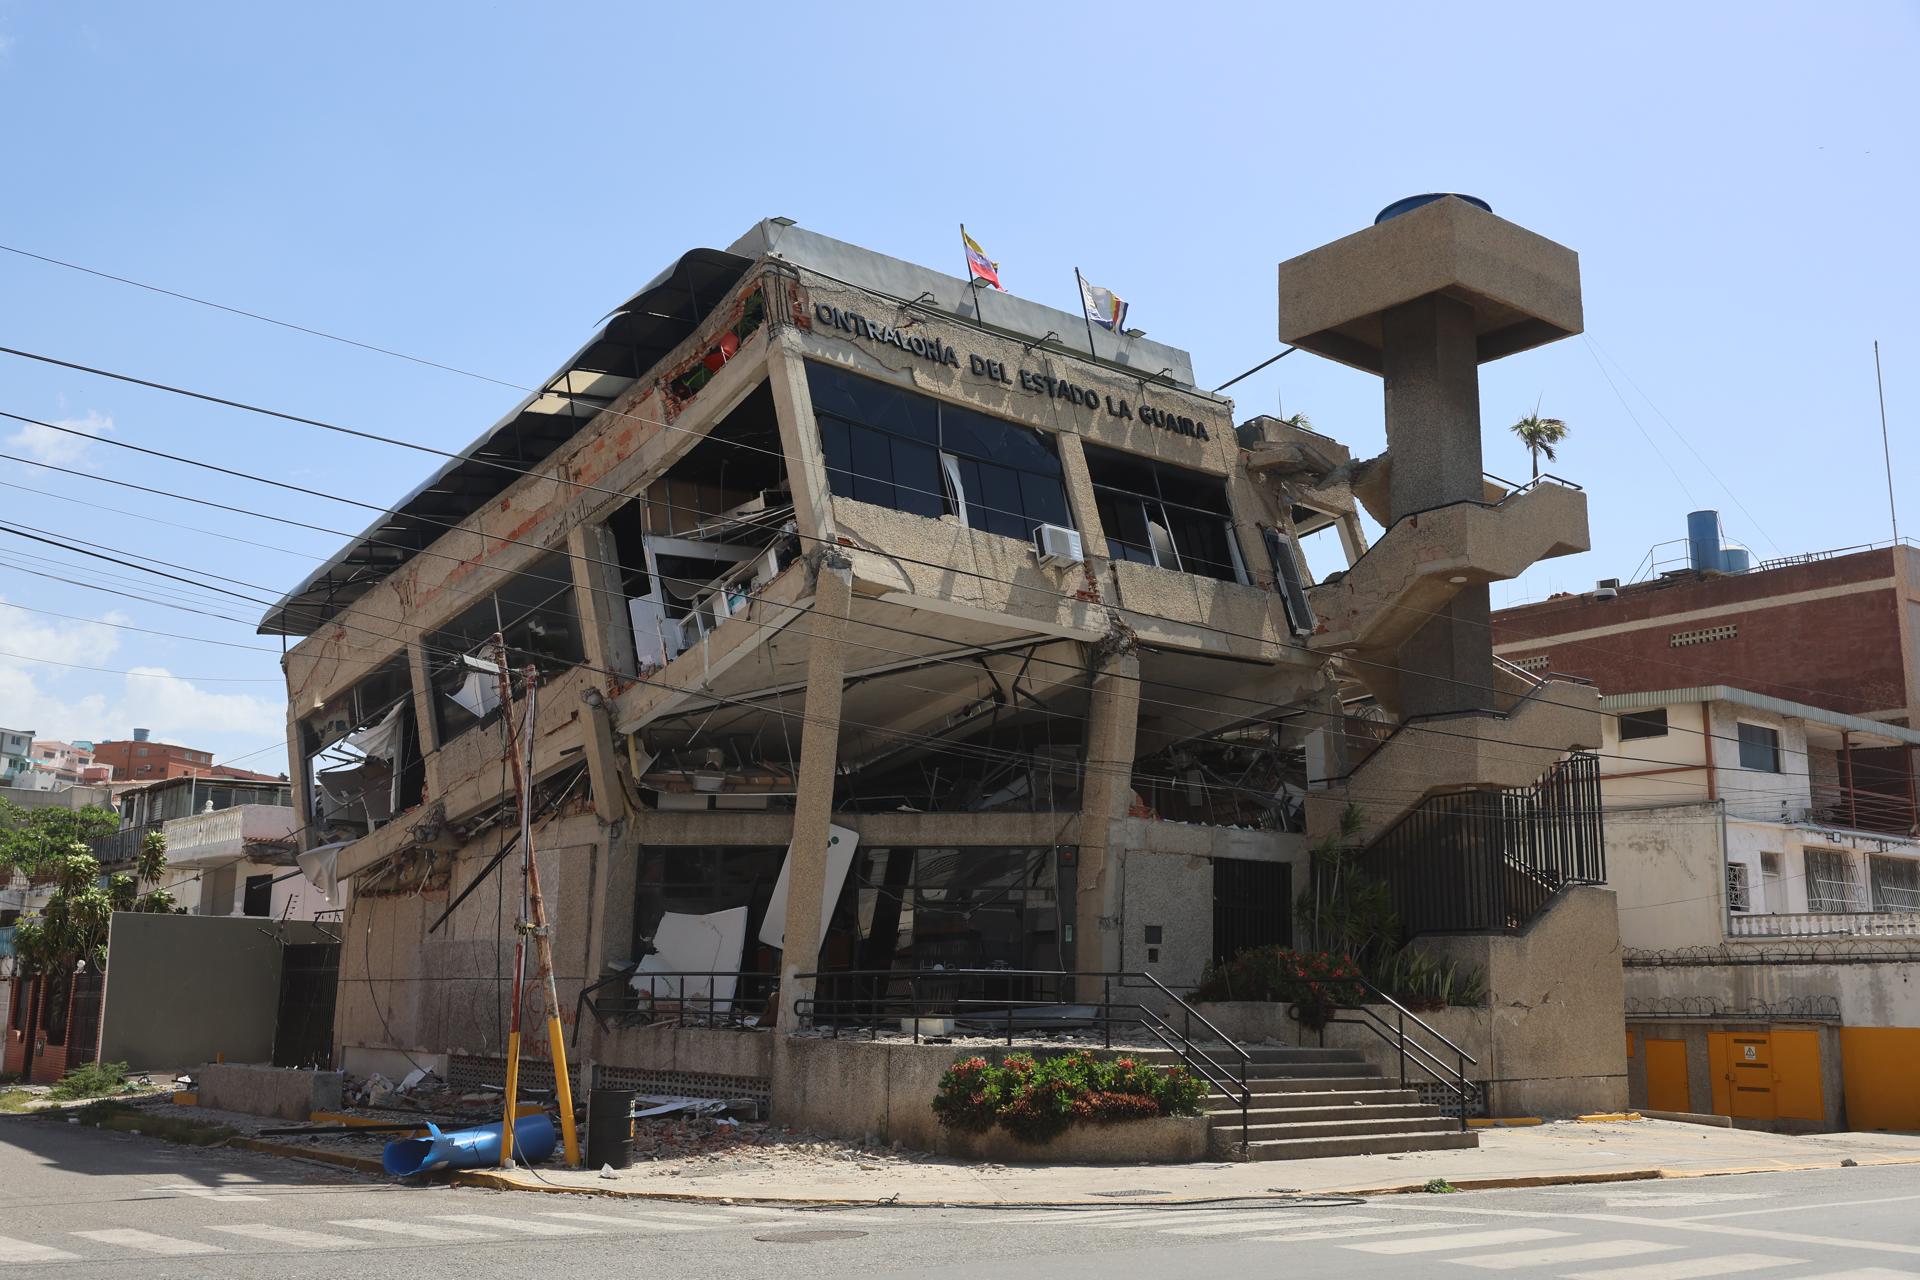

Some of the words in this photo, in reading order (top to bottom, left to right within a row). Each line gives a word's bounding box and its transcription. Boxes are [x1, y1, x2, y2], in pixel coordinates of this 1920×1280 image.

[969, 353, 1013, 385] DEL
[1020, 369, 1100, 410] ESTADO
[1105, 395, 1134, 421] LA
[1139, 404, 1210, 442] GUAIRA
